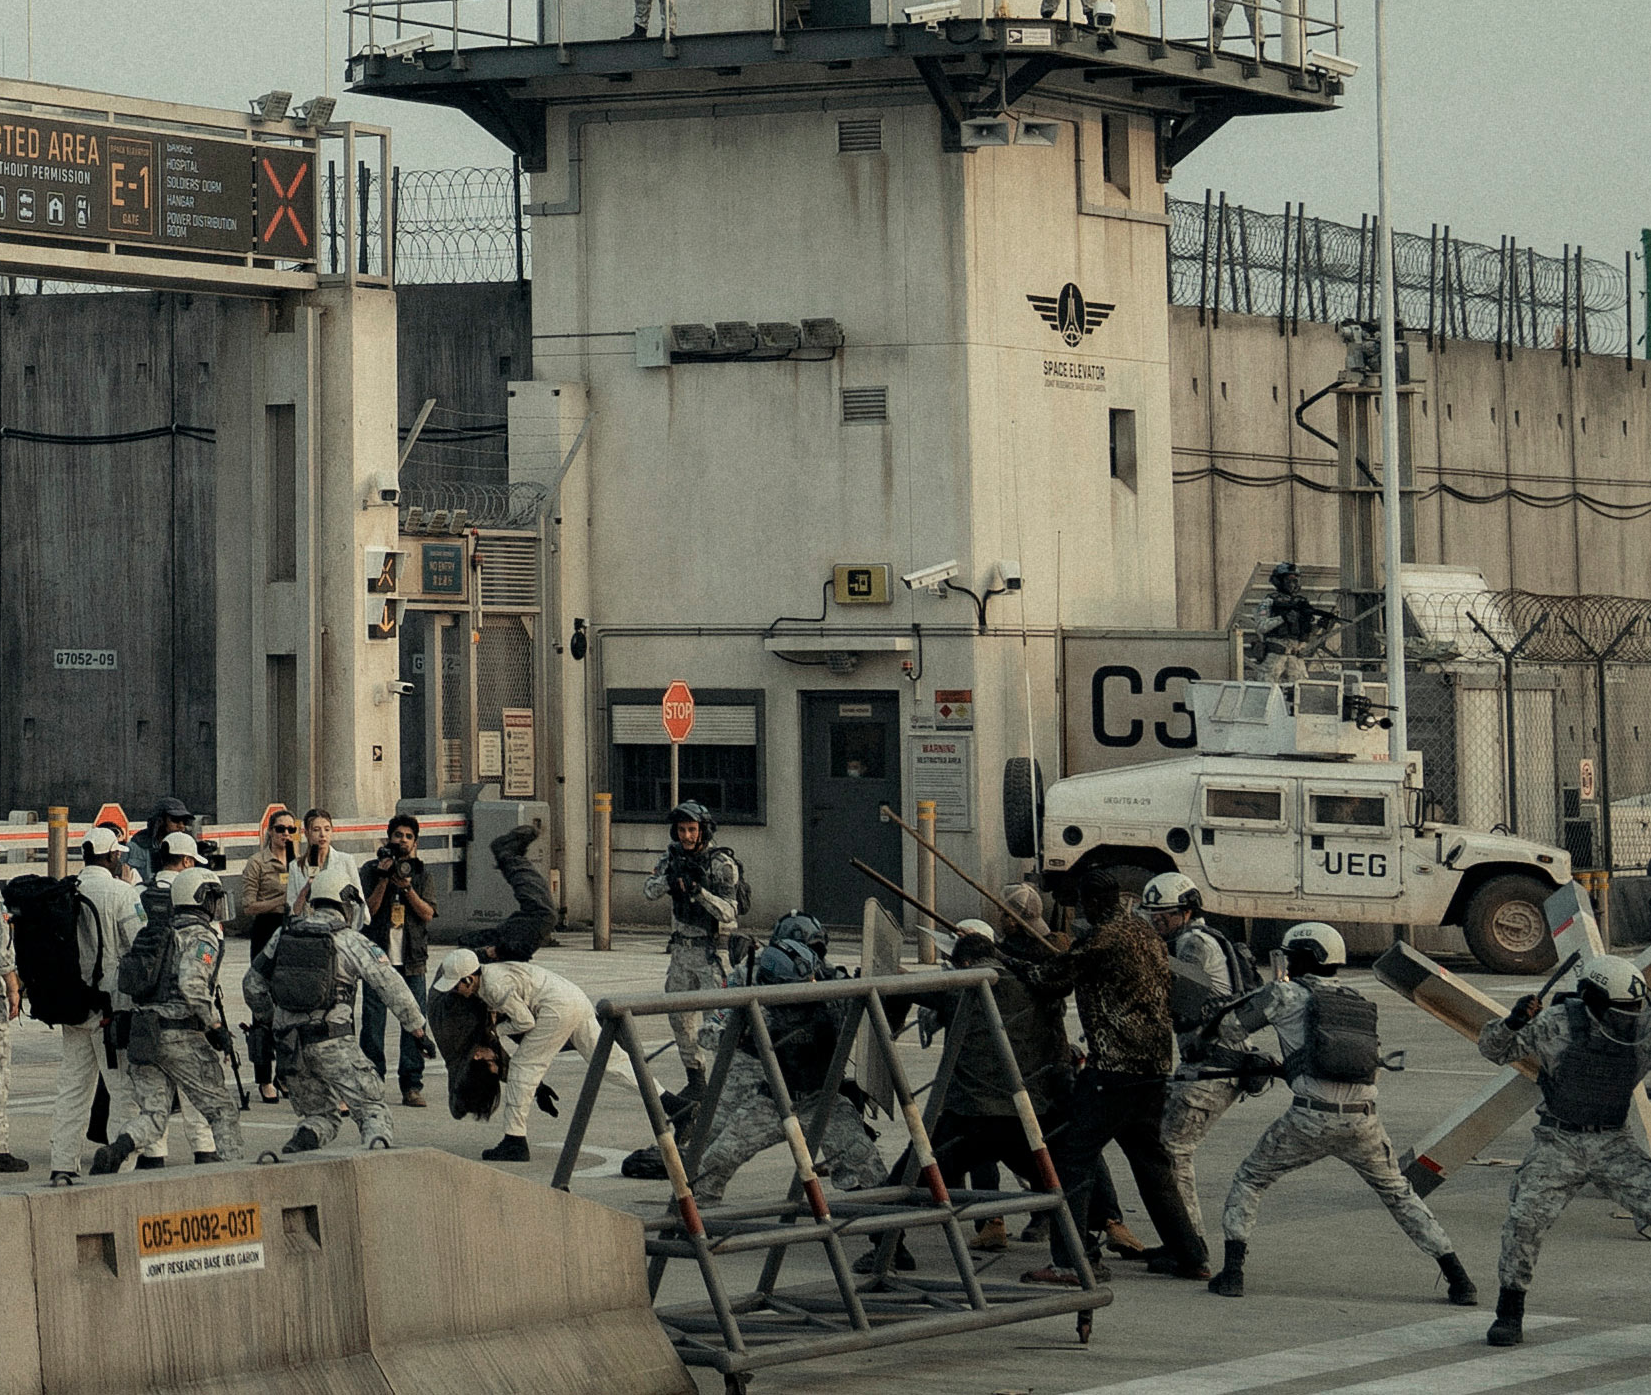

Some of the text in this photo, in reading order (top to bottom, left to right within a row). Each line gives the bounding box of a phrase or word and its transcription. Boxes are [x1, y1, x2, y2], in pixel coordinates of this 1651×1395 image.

[48, 129, 100, 166] AREA
[32, 165, 91, 185] PERMISSION
[166, 158, 199, 174] HOSPITAL
[111, 162, 149, 209] E-1
[122, 212, 140, 226] GATE
[166, 212, 191, 227] POWER
[166, 225, 187, 239] ROOM
[1043, 360, 1105, 381] SPACE ELEVATOR
[56, 652, 115, 666] G7052-09
[664, 701, 693, 721] STOP
[1091, 665, 1201, 749] C3
[922, 744, 956, 754] WARNING
[1324, 851, 1387, 878] UEG
[1589, 970, 1610, 986] UEG
[142, 1208, 256, 1249] C05-0092-03T
[145, 1262, 165, 1278] JOINT
[167, 1257, 203, 1276] RESEARCH
[204, 1254, 221, 1270] BASE
[222, 1252, 236, 1267] UEG
